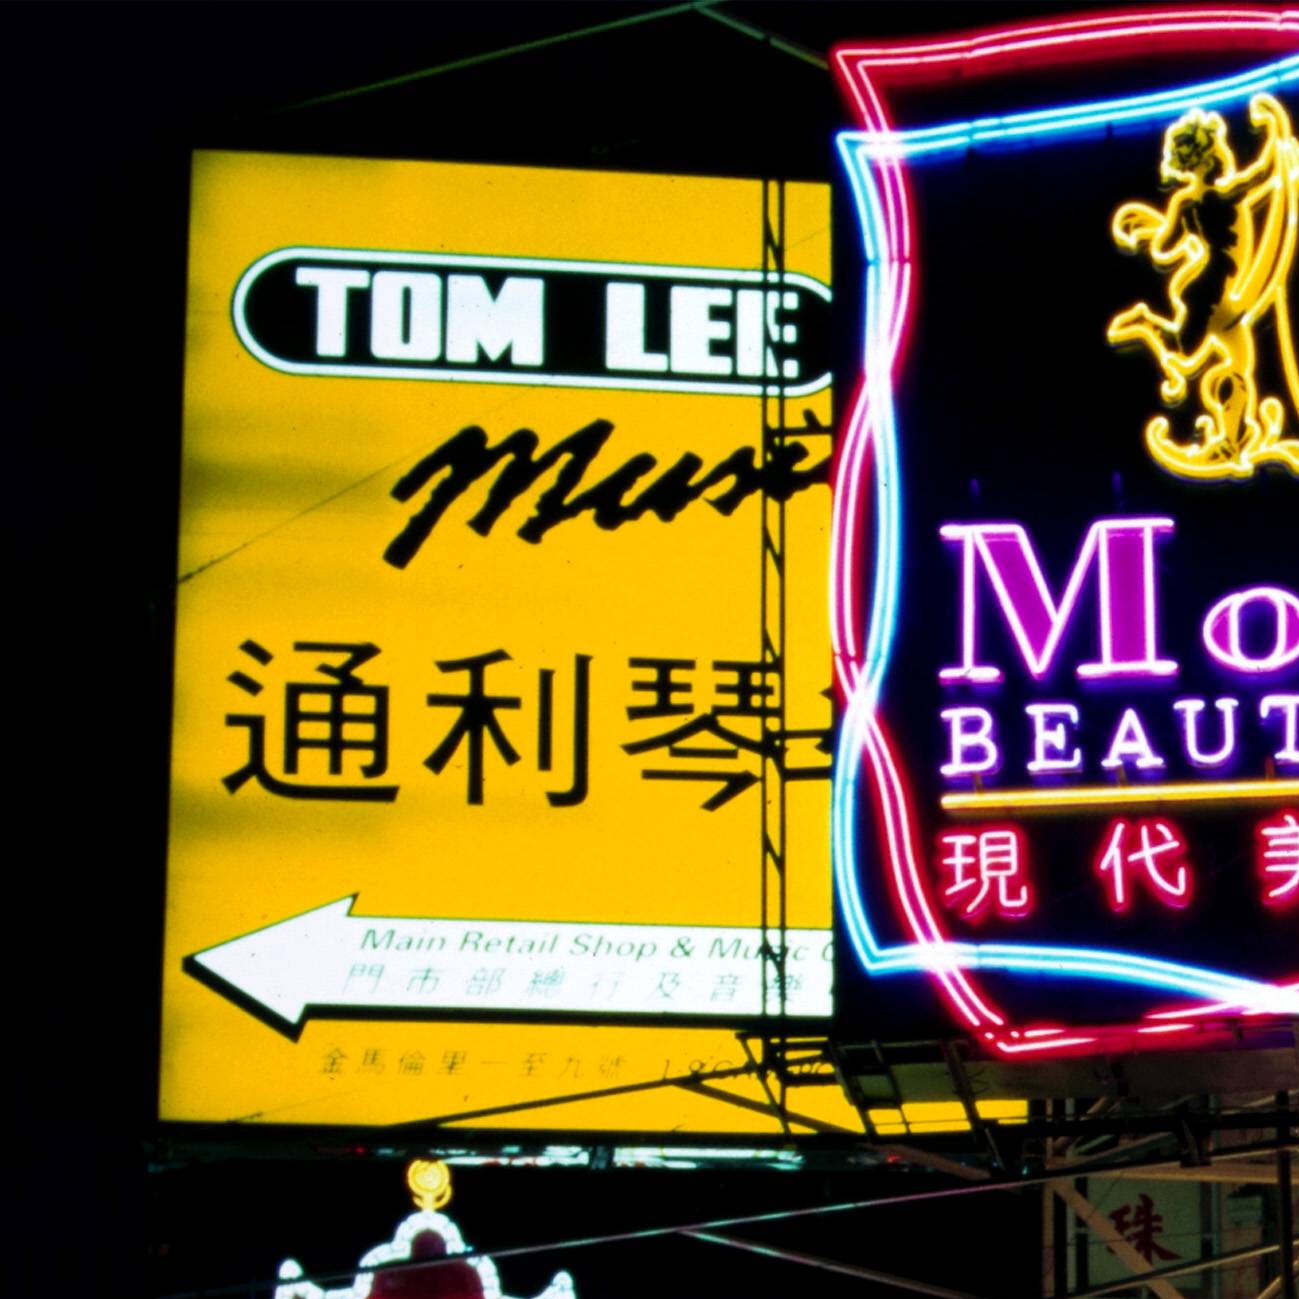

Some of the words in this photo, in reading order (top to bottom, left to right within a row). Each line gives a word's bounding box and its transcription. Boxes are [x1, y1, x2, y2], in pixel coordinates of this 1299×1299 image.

[295, 267, 545, 366] TOM
[605, 282, 800, 379] LEE
[221, 637, 832, 812] 通利琴
[360, 927, 447, 953] Main
[458, 930, 558, 955] Retail
[569, 931, 657, 961] Shop
[669, 935, 697, 957] &
